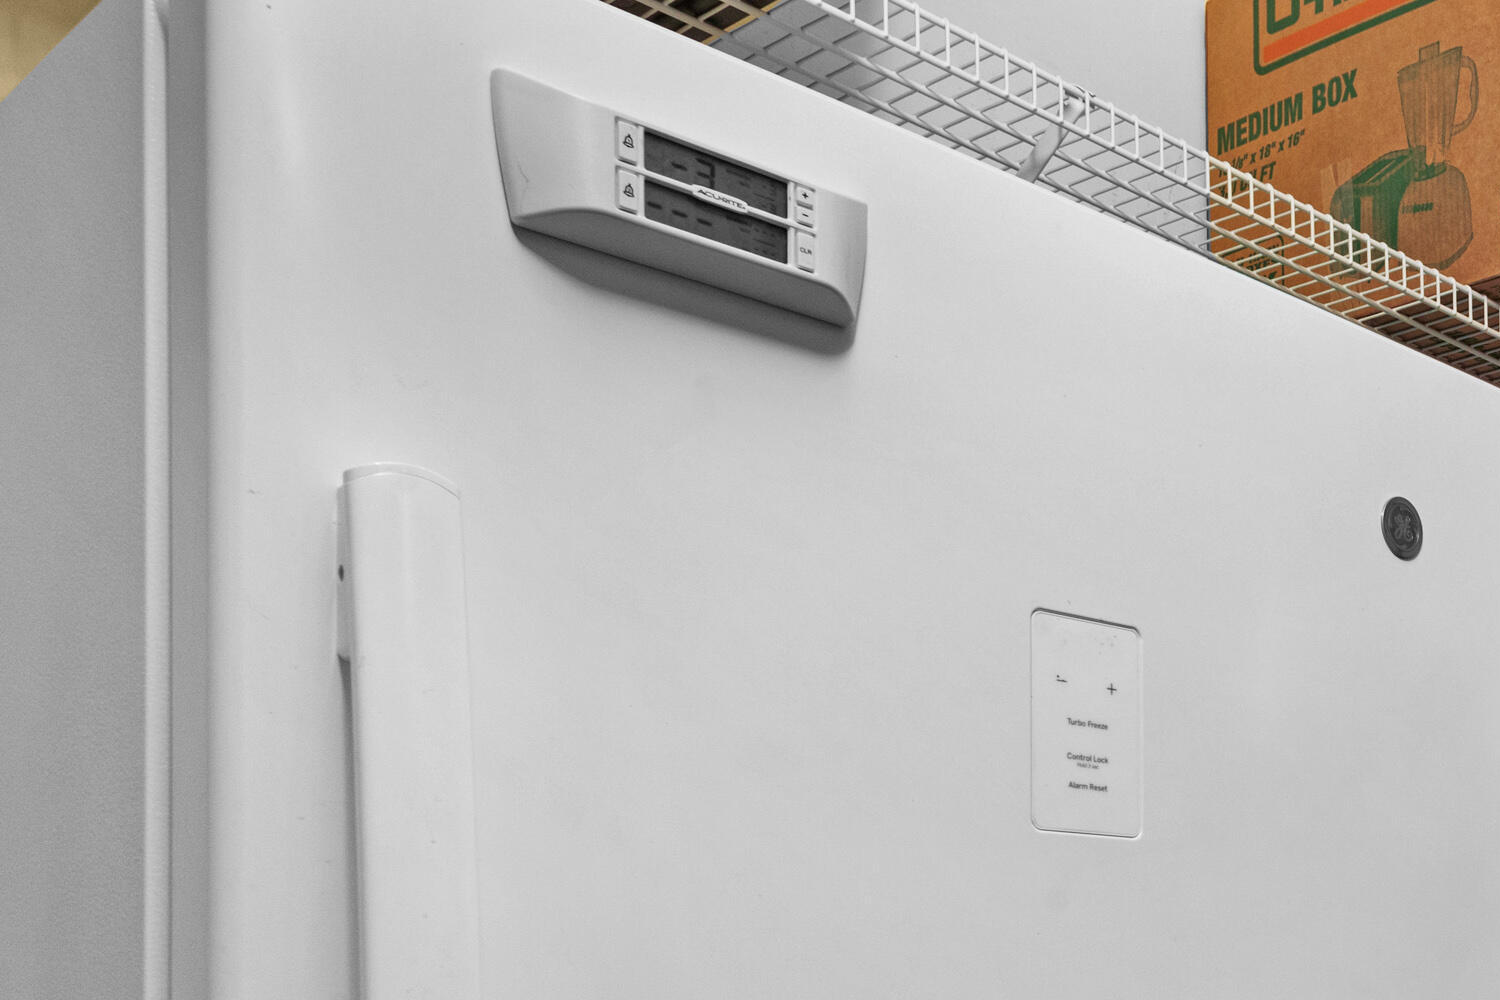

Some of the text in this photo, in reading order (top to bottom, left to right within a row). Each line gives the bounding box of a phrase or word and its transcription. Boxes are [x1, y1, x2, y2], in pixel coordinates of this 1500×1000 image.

[1217, 69, 1358, 155] MEDIUM BOX
[1260, 161, 1277, 182] FT
[800, 247, 812, 255] CLR
[1067, 717, 1108, 730] Turbo Freeze
[1067, 752, 1108, 764] Control Lock
[1068, 781, 1108, 792] Alarm Reset
